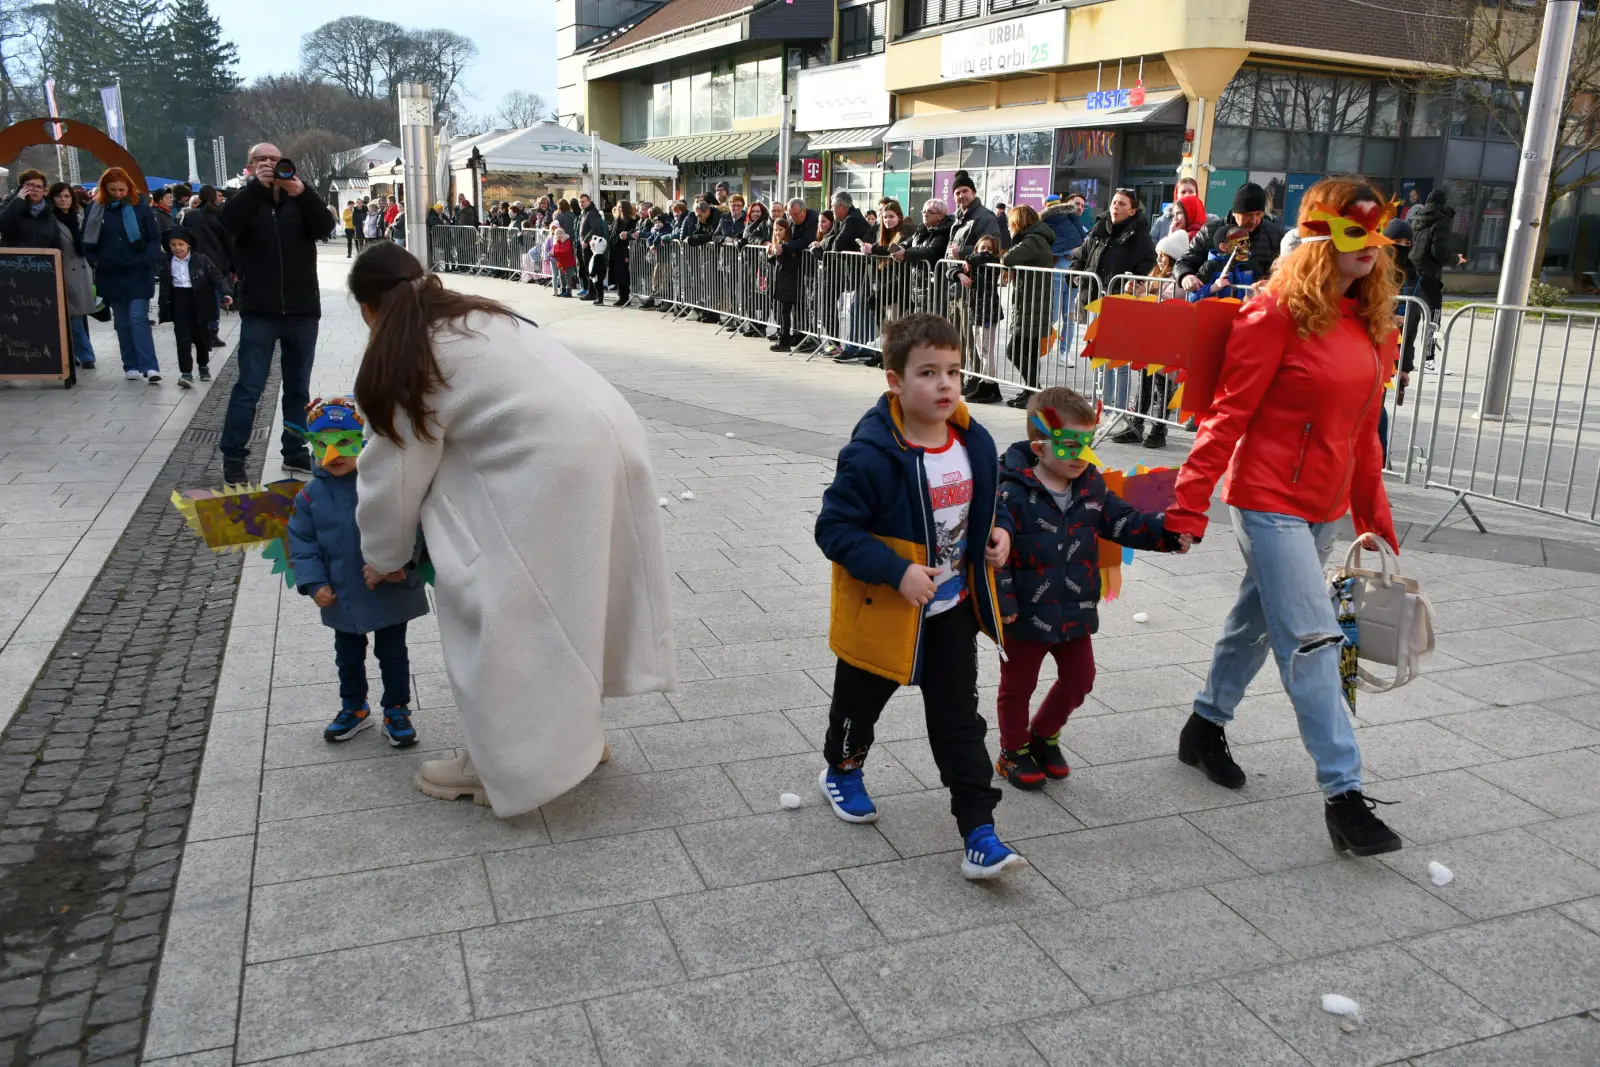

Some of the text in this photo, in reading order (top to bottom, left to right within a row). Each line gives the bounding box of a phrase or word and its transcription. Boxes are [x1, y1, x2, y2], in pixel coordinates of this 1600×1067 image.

[988, 22, 1025, 46] URBIA
[980, 53, 993, 72] et
[1030, 42, 1050, 64] 25
[1086, 88, 1129, 110] ERSTE
